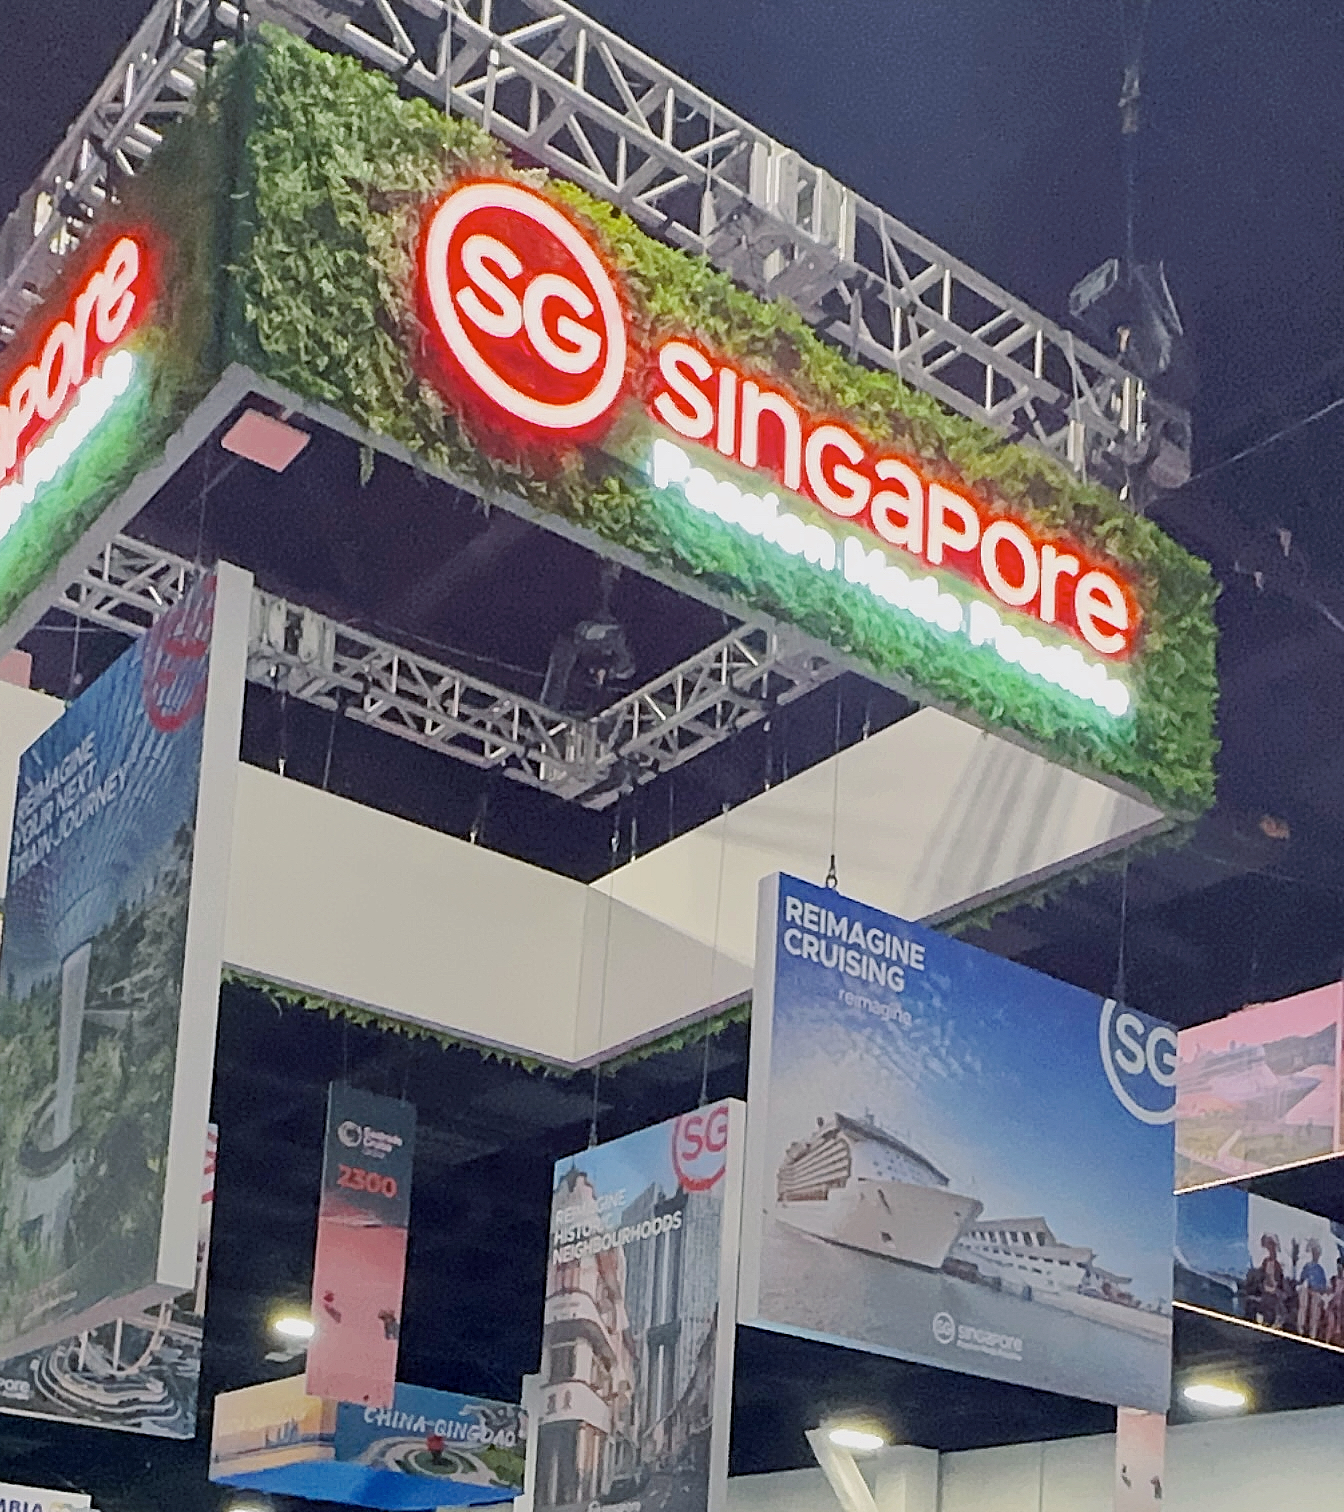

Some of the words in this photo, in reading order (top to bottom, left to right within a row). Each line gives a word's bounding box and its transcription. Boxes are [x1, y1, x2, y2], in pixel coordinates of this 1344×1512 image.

[456, 233, 603, 375] SG
[50, 764, 127, 847] JOURNEY
[55, 758, 98, 817] NEXT
[783, 927, 905, 993] CRUISING
[785, 895, 926, 972] REIMAGINE
[1115, 1012, 1178, 1087] SG
[680, 1104, 729, 1161] SG
[552, 1209, 683, 1266] NEIGHBOURHOODS
